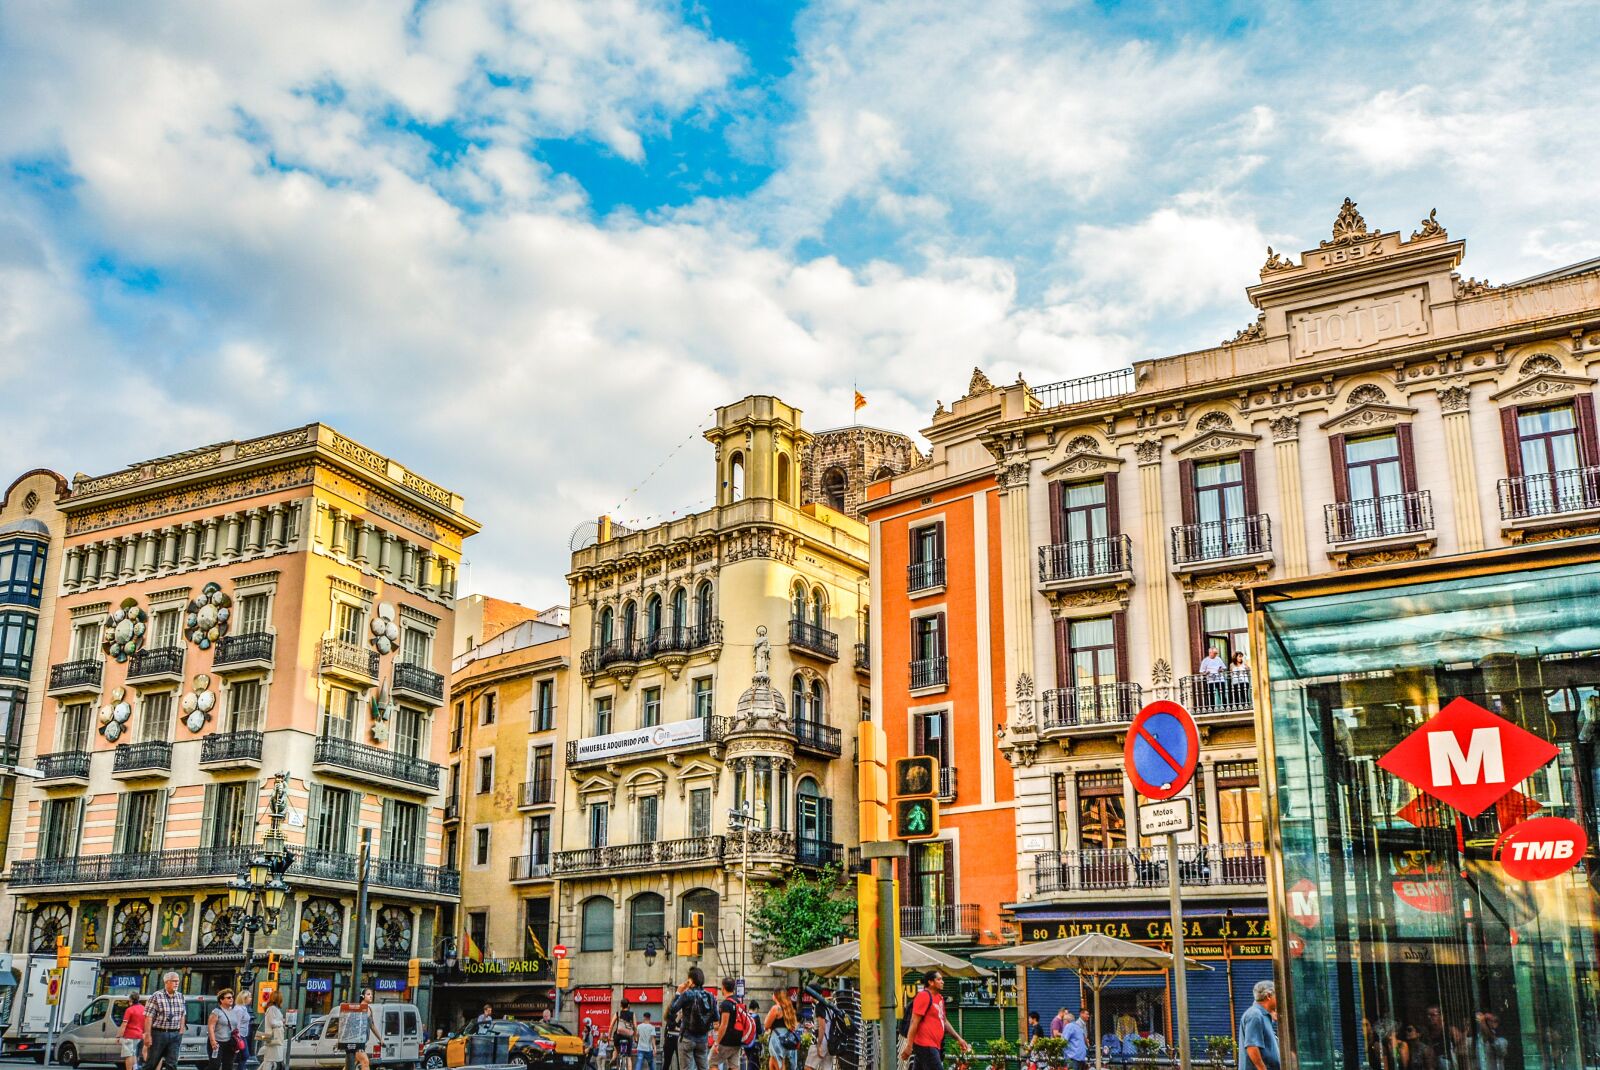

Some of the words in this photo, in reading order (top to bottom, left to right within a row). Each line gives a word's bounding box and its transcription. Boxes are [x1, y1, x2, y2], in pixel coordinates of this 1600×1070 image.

[1320, 240, 1383, 266] 1894
[1302, 300, 1415, 349] HOTEL
[579, 742, 606, 754] INMUEBLE
[606, 737, 637, 750] ADQUIRIDO
[637, 735, 650, 745] POR
[1426, 726, 1506, 788] M
[1152, 808, 1173, 817] Motos
[1146, 822, 1155, 830] en
[1157, 818, 1183, 827] andana
[1511, 839, 1575, 861] TMB
[1033, 928, 1049, 940] 80
[1057, 923, 1131, 939] ANTIGA
[1146, 921, 1204, 938] CASA
[1218, 920, 1238, 937] J.
[1190, 945, 1222, 954] INTERIOR
[1239, 945, 1261, 954] PREU
[464, 962, 502, 974] HOSTAL
[508, 960, 539, 973] PARIS
[118, 976, 136, 986] BBVA
[306, 979, 327, 990] BBVA
[379, 979, 397, 989] BBVA
[583, 993, 611, 1002] Santander
